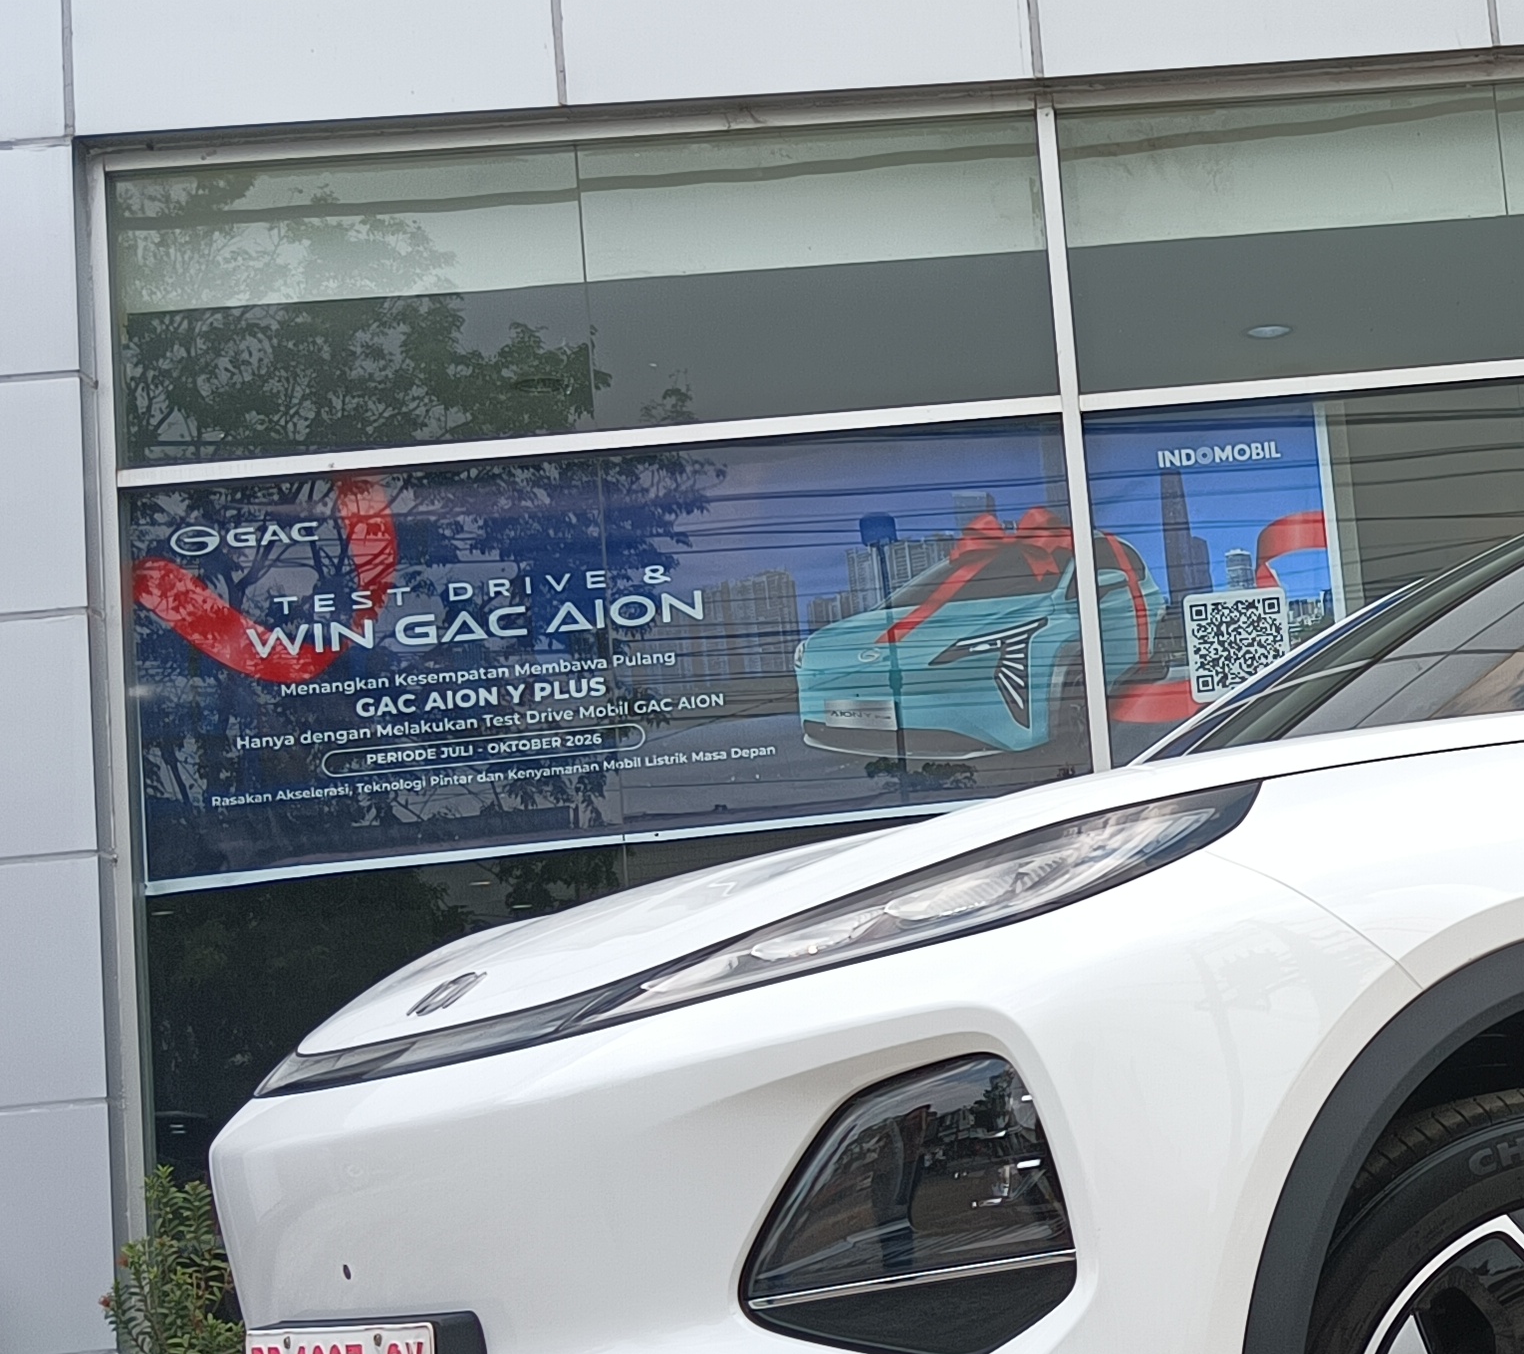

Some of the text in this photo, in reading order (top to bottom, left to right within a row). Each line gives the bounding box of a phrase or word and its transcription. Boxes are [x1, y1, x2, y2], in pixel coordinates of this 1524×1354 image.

[1157, 441, 1281, 468] INDOMOBIL
[226, 521, 320, 548] GAC
[273, 565, 672, 615] TEST DRIVE &
[246, 590, 705, 659] WIN GAC AION
[280, 652, 676, 697] Menangkan Kesempatan Membawa Pulang
[355, 677, 607, 718] GAC AION Y PLUS
[236, 693, 725, 751] Hanya dengan Melakukan Test Drive Mobil GAC AION
[366, 748, 437, 765] PERIODE
[440, 745, 474, 760] JULI
[487, 738, 562, 755] OKTOBER
[566, 733, 603, 748] 2026
[211, 745, 777, 807] Rasakan Akselerasi, Teknologi Pintar dan Kenyamanan Mobil Listrik Masa Depan
